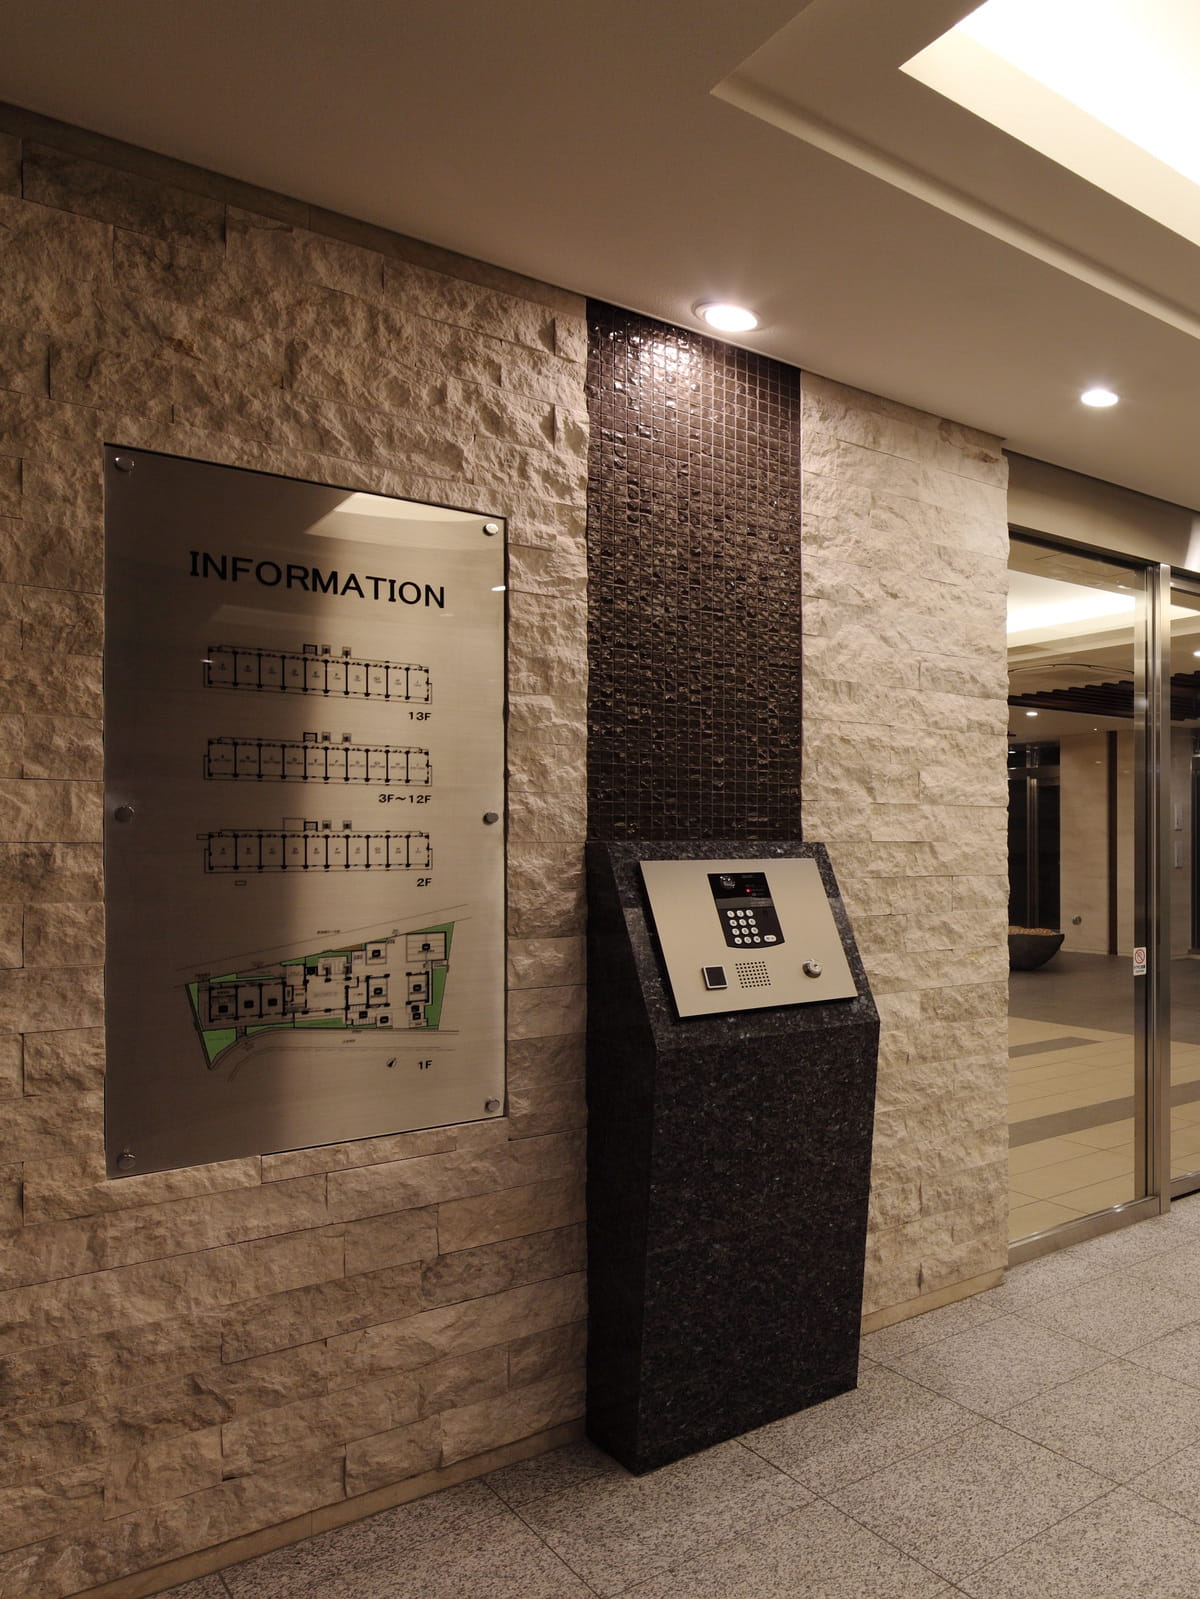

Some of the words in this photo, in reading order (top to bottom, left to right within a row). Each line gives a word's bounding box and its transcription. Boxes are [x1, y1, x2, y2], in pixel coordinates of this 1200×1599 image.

[190, 551, 445, 608] INFORMATION
[408, 711, 432, 721] 13F
[416, 877, 432, 887] 2F
[418, 1060, 432, 1070] 1F
